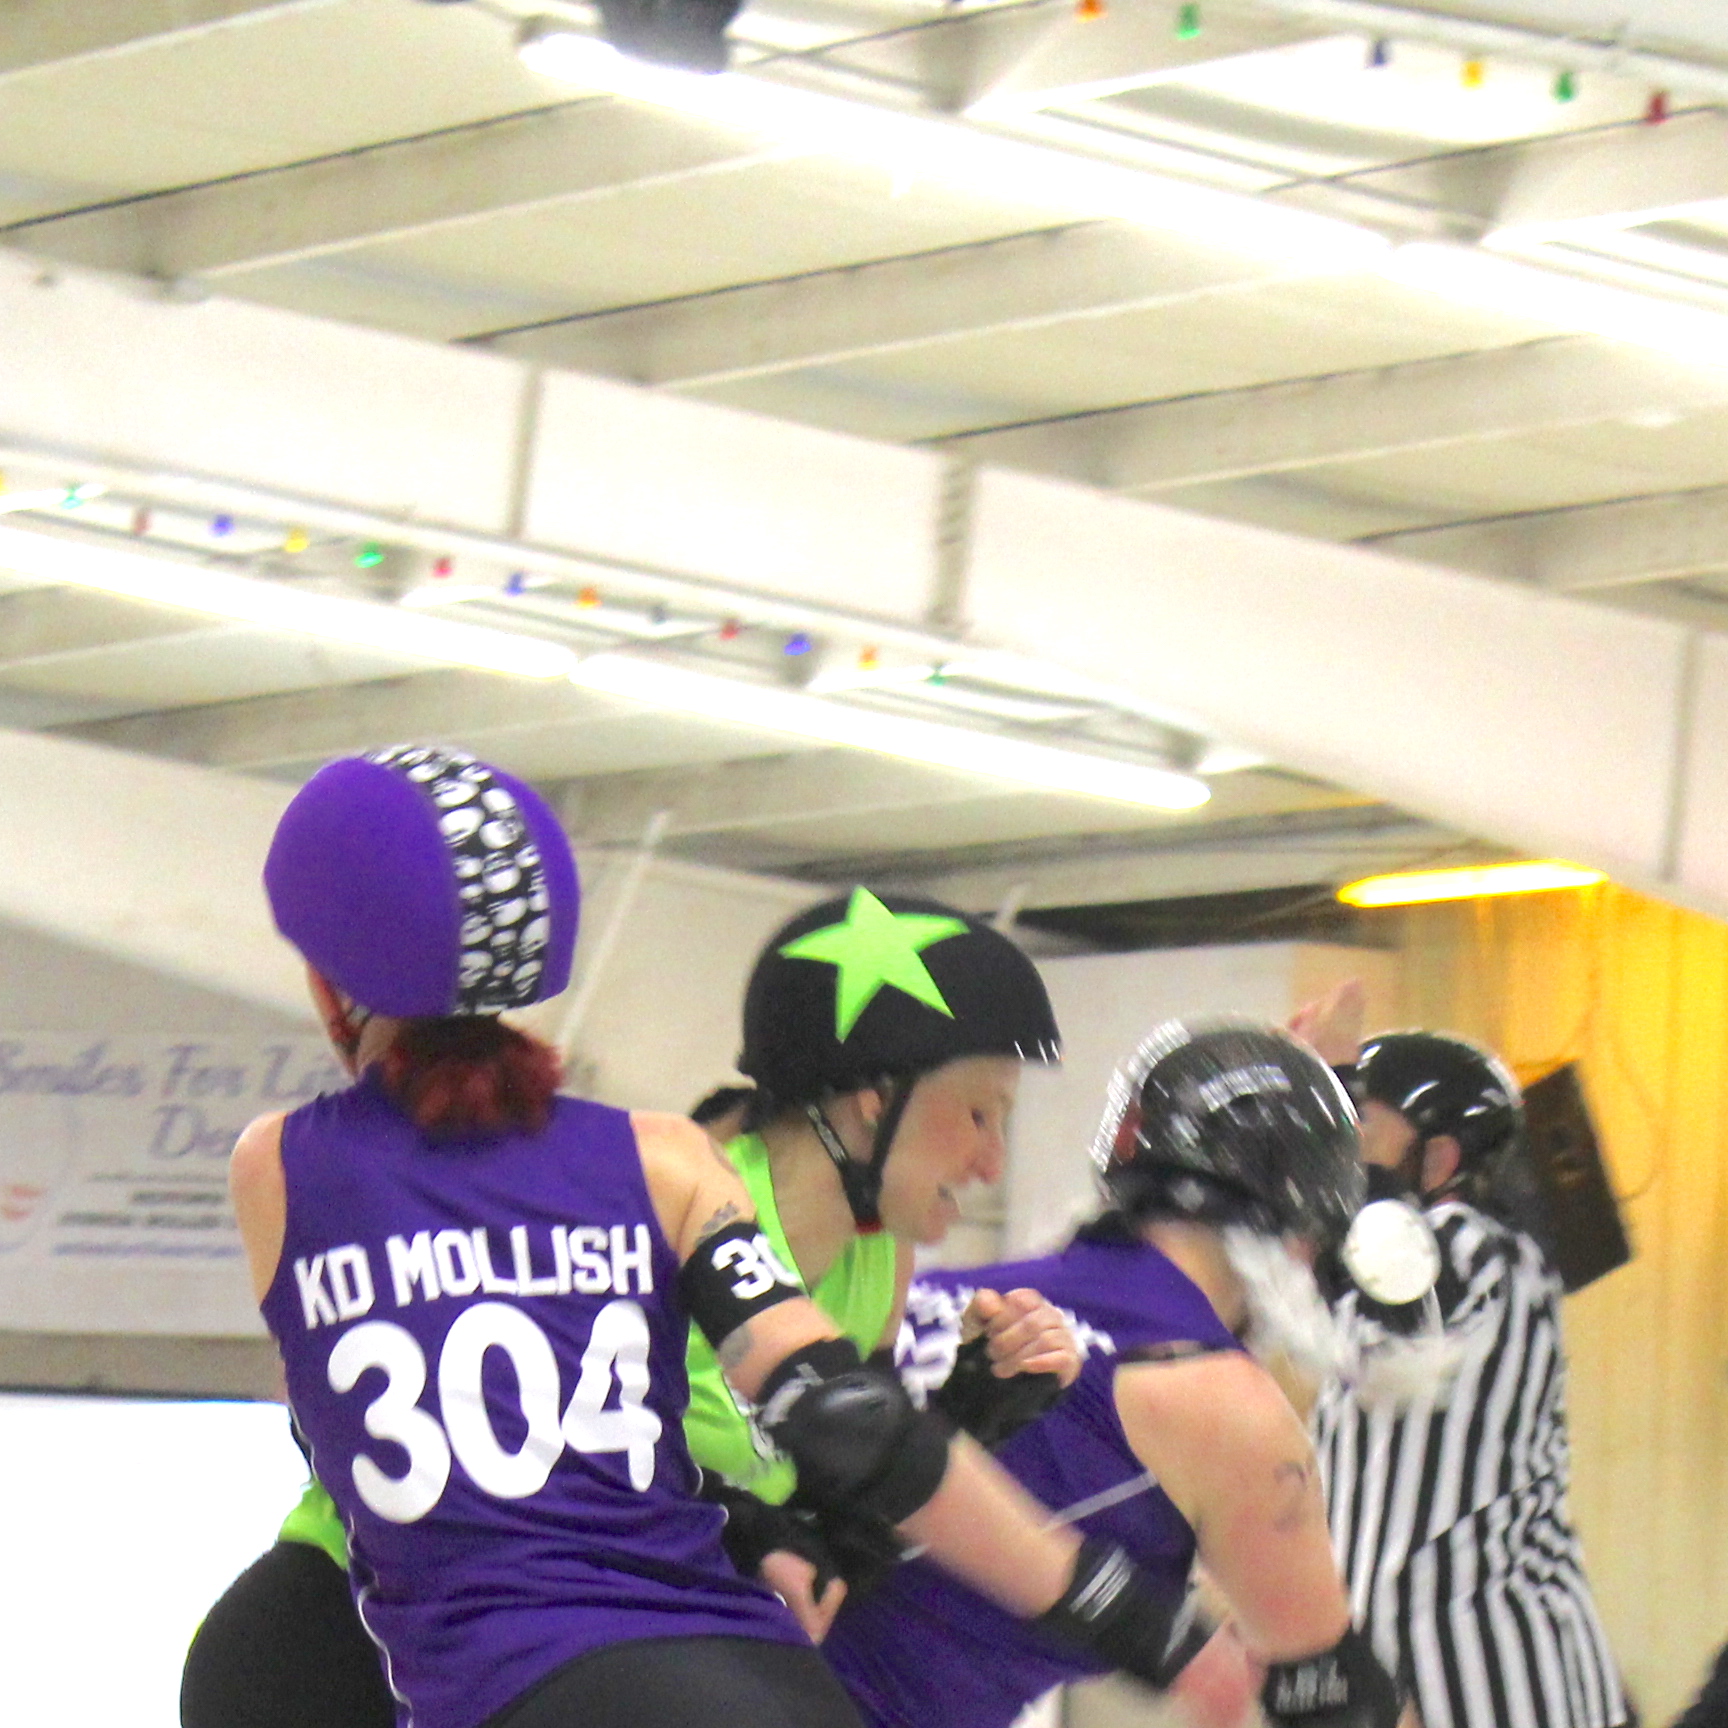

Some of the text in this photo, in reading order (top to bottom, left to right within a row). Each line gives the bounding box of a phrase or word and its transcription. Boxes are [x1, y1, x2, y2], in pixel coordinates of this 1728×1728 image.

[293, 1223, 655, 1330] KD MOLLISH
[327, 1299, 663, 1524] 304
